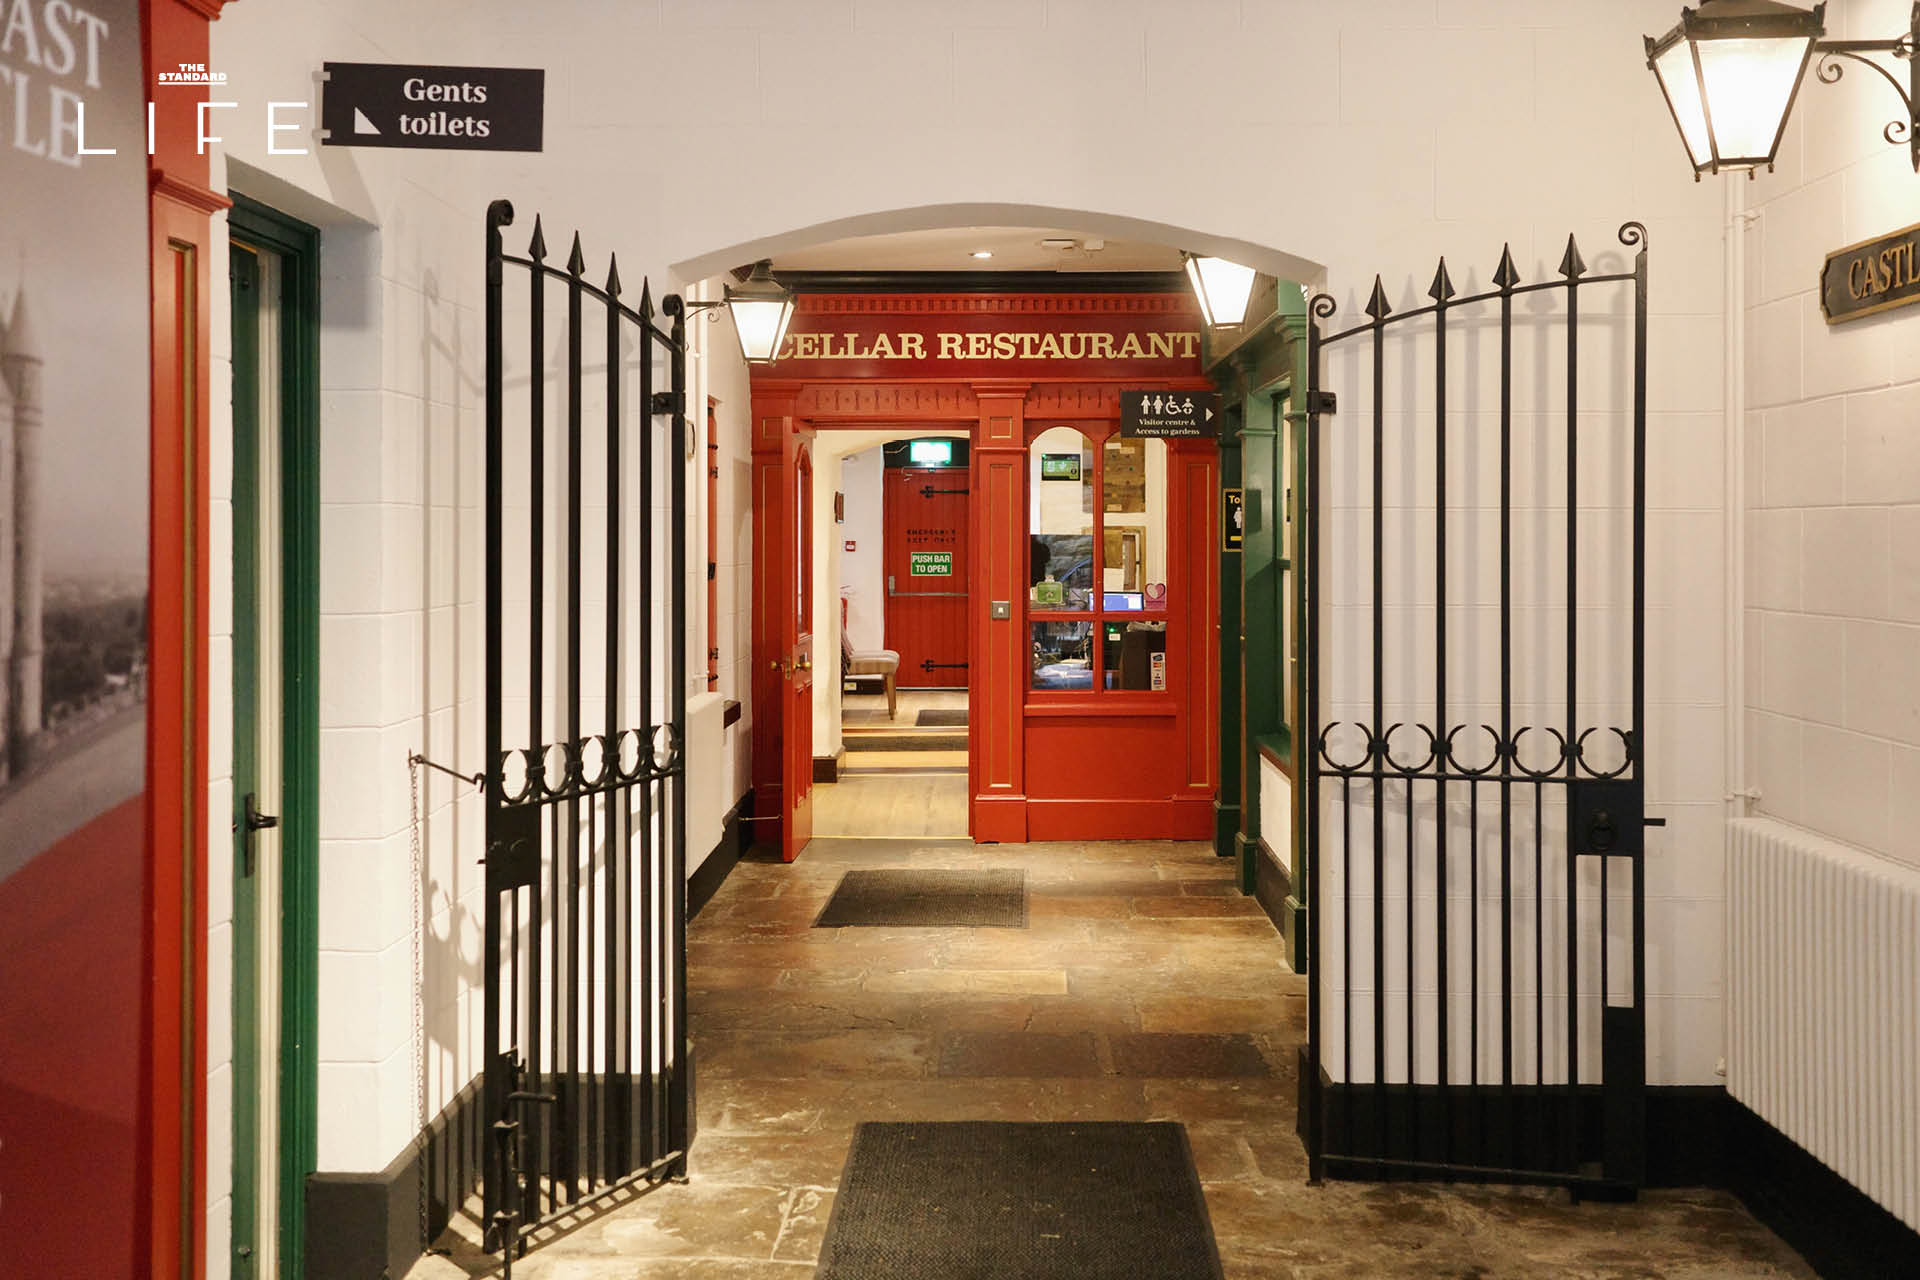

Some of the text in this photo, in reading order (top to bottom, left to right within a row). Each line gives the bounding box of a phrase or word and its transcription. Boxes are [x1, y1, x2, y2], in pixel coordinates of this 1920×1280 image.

[0, 0, 109, 88] AST
[403, 78, 487, 104] Gents
[399, 111, 490, 137] toilets
[937, 332, 1200, 360] RESTAURANT
[1139, 418, 1164, 426] Visitor
[1165, 418, 1190, 426] centre
[1135, 427, 1200, 436] Access to gardens
[912, 555, 950, 563] PUSH BAR
[916, 565, 947, 573] TO OPEN
